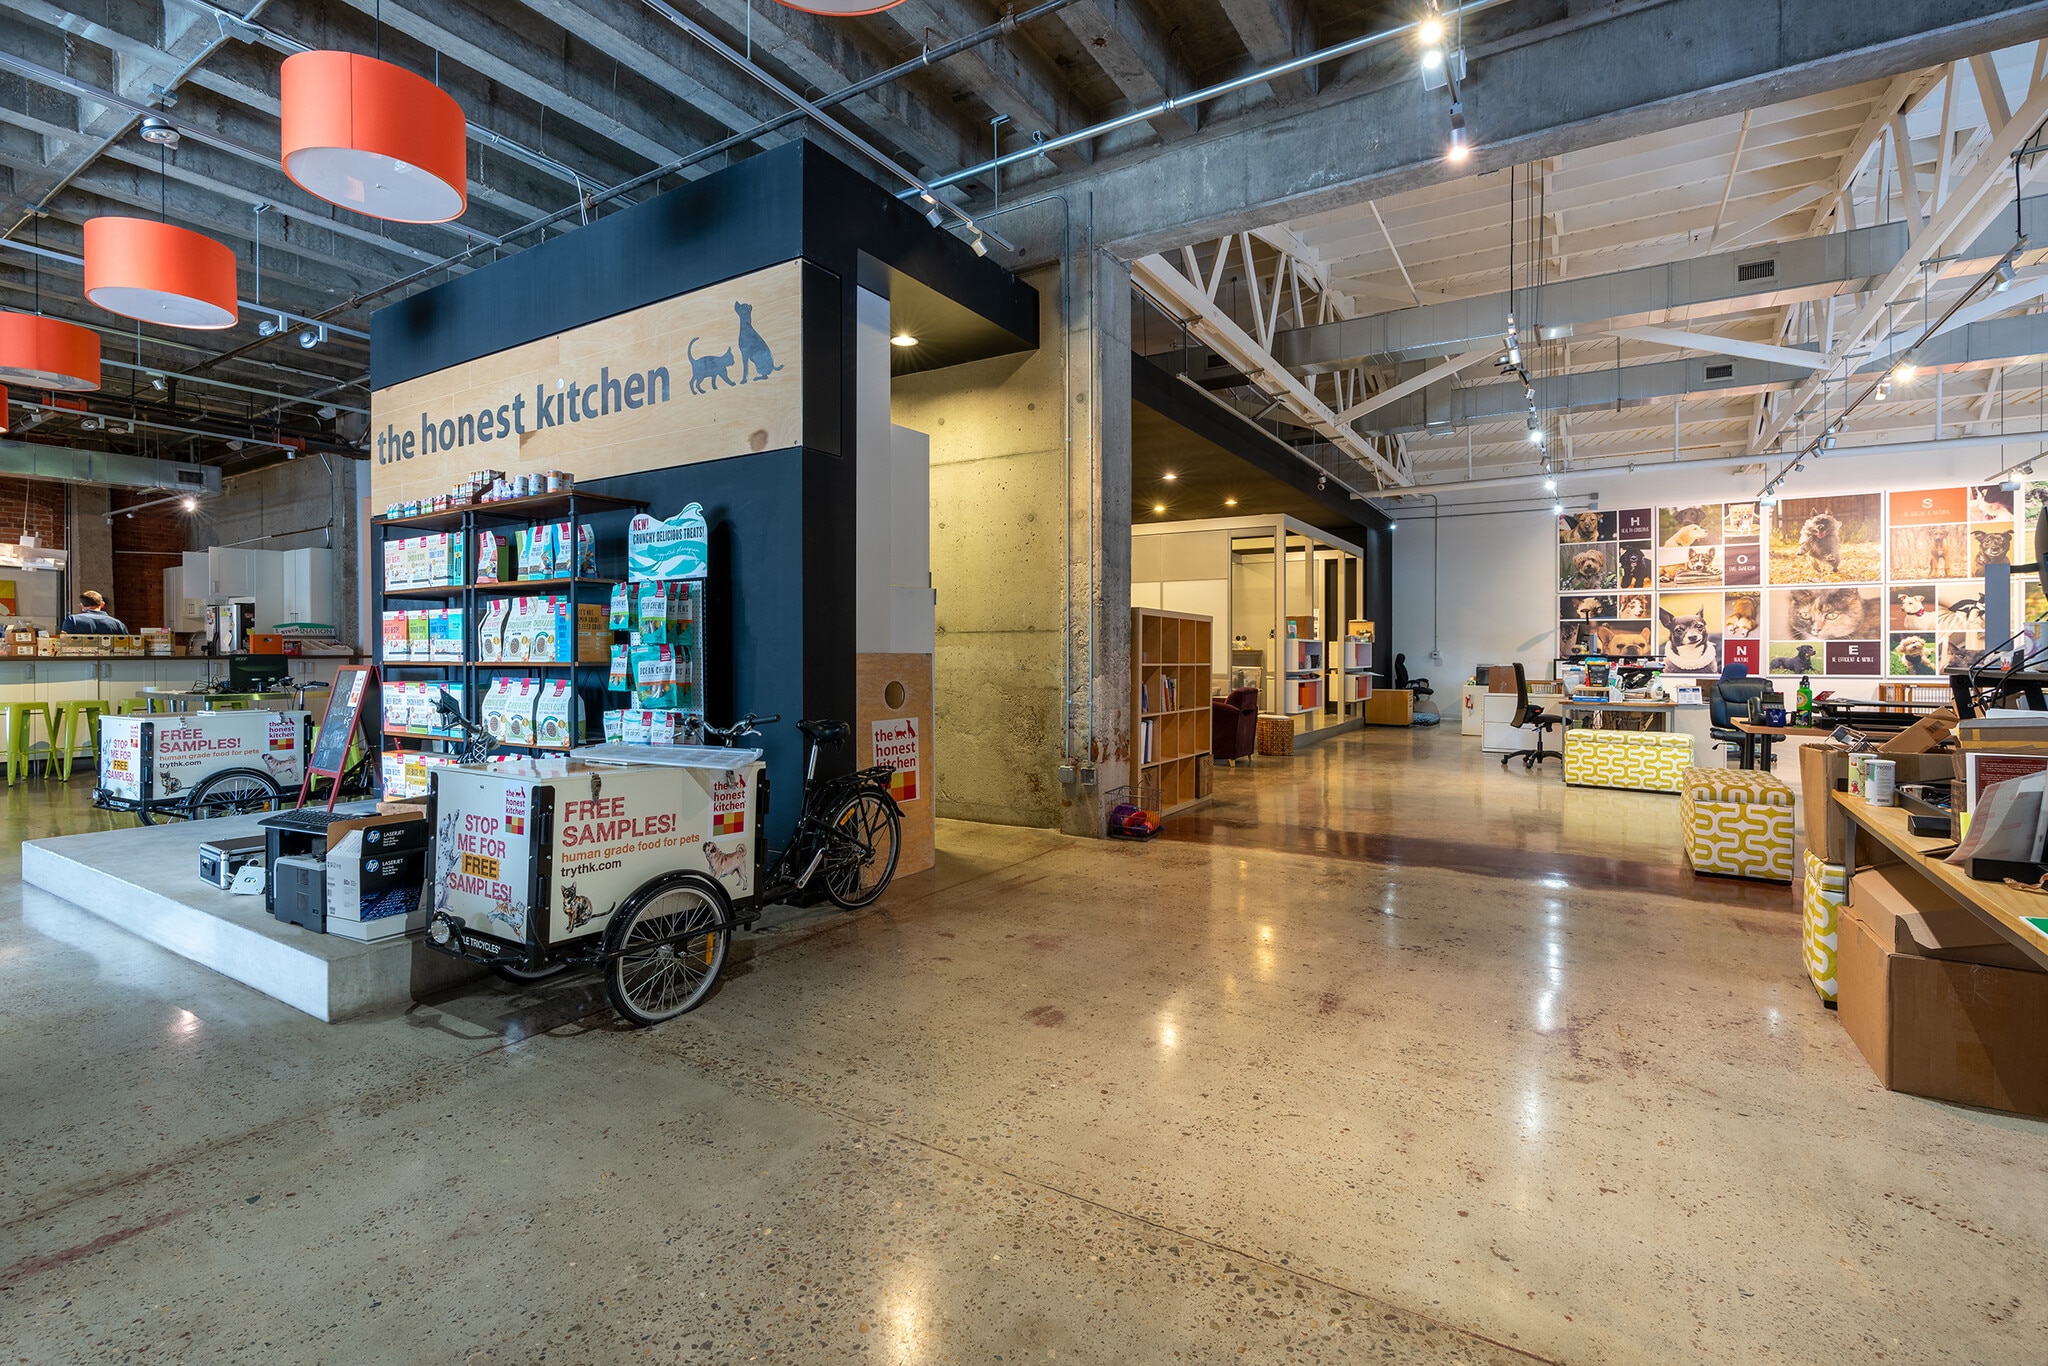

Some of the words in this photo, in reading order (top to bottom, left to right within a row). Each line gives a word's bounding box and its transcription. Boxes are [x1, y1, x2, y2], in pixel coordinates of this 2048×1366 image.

[378, 424, 415, 465] the
[421, 393, 526, 455] honest
[536, 366, 670, 431] kitchen
[1922, 498, 1934, 508] S
[632, 518, 649, 531] NEW!
[1630, 516, 1640, 526] H
[632, 530, 656, 544] CRUNCHY
[656, 528, 682, 542] DELICIOUS
[684, 526, 705, 540] TREATS!
[1736, 554, 1748, 564] O
[1736, 646, 1747, 656] N
[1848, 645, 1859, 655] E
[640, 666, 655, 675] OCEAN
[656, 666, 672, 674] CHEWS
[160, 728, 203, 740] FREE
[874, 729, 893, 742] the
[113, 739, 128, 749] STOP
[160, 738, 241, 753] SAMPLES!
[876, 742, 916, 757] honest
[111, 750, 119, 759] ME
[120, 750, 131, 760] FOR
[114, 760, 128, 770] FREE
[159, 760, 202, 769] trythk.com
[876, 756, 917, 770] kitchen
[106, 770, 134, 782] SAMPLES!
[714, 782, 727, 791] the
[506, 789, 515, 797] the
[713, 790, 746, 802] honest
[506, 797, 526, 808] honest
[713, 800, 746, 812] kitchen
[506, 806, 526, 816] kitchen
[564, 796, 625, 822] FREE
[465, 814, 499, 835] STOP
[562, 814, 677, 848] SAMPLES!
[458, 833, 477, 853] ME
[480, 838, 506, 858] FOR
[561, 850, 600, 863] human
[604, 844, 635, 858] grade
[638, 840, 661, 851] food
[664, 837, 678, 847] for
[680, 833, 700, 847] pets
[464, 855, 497, 878] FREE
[560, 858, 622, 878] trythk.com
[449, 872, 512, 903] SAMPLES!
